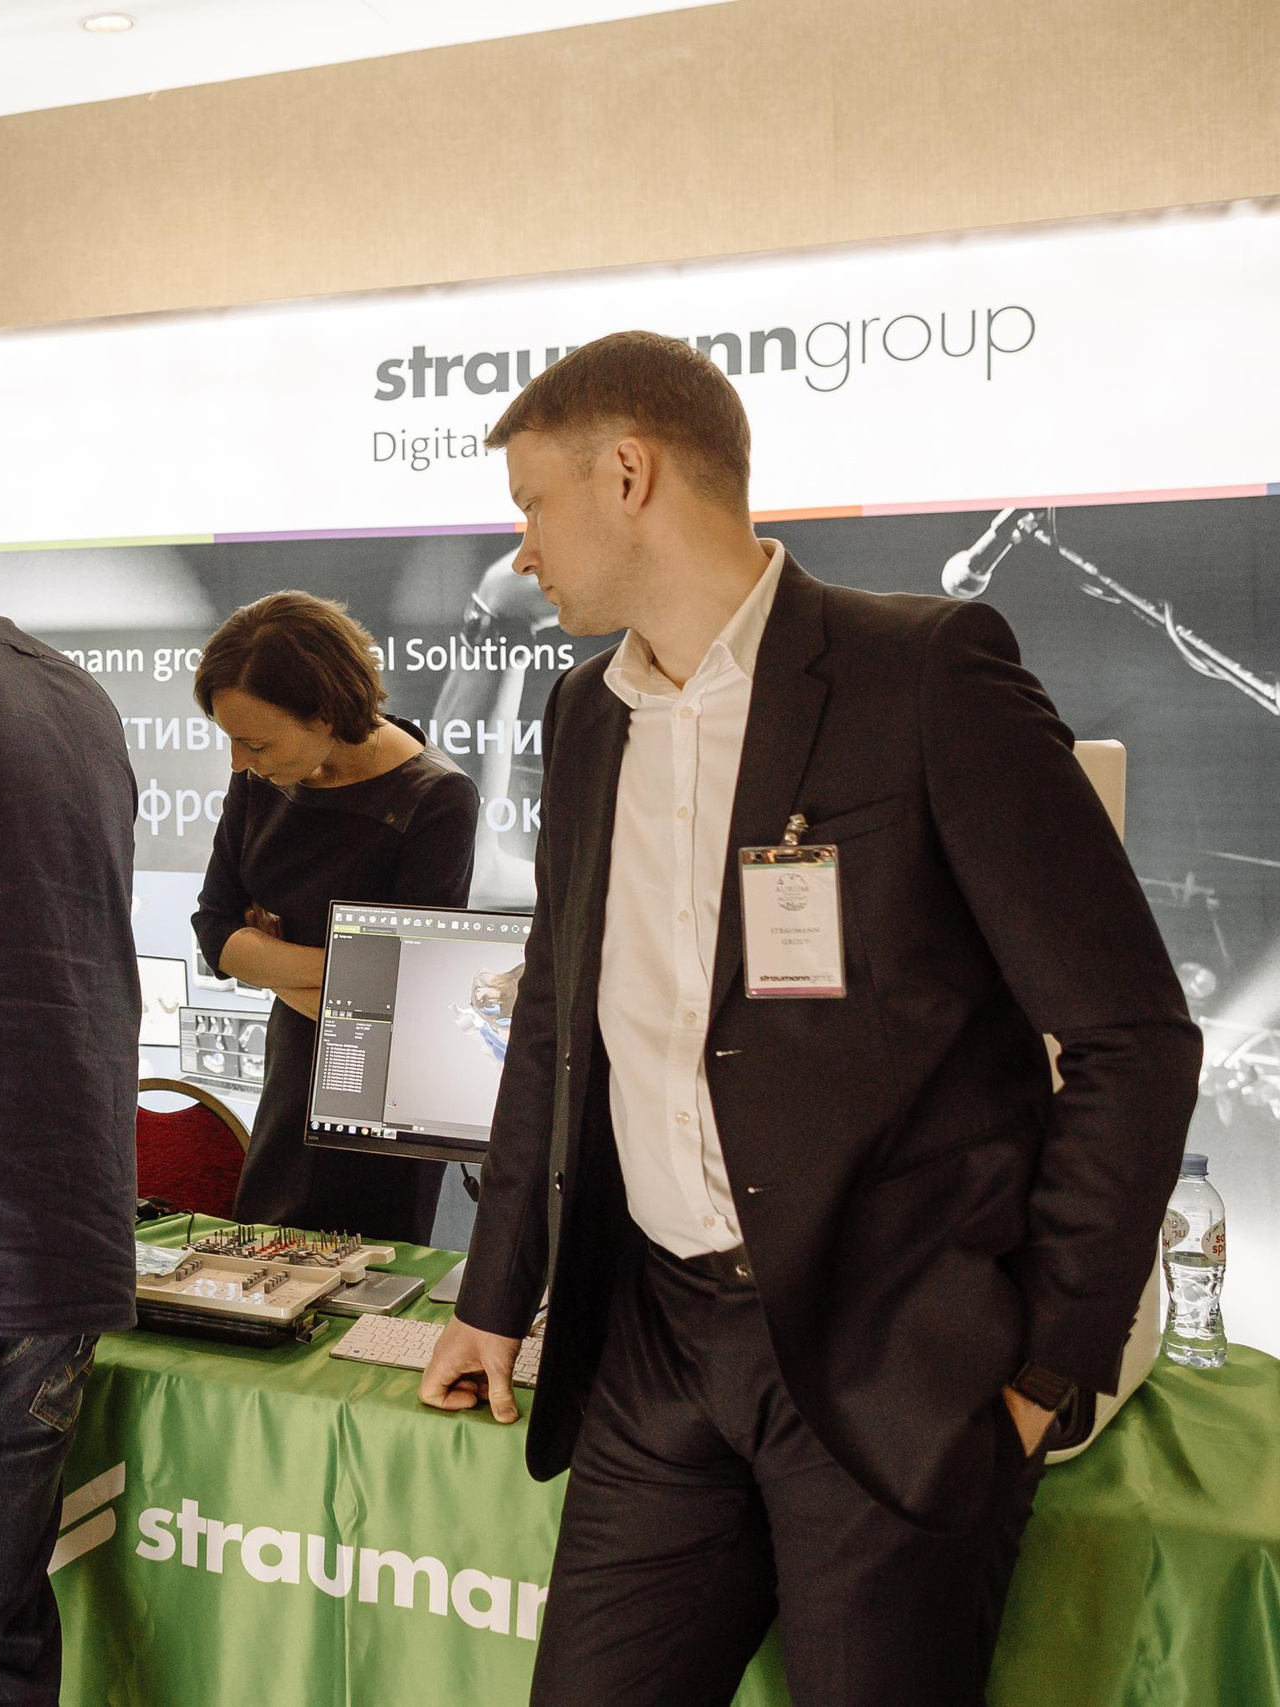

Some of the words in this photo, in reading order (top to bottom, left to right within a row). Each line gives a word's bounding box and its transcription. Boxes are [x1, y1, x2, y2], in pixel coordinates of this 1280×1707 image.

[374, 305, 1036, 402] straunngroup
[373, 423, 488, 471] Digital
[405, 636, 575, 672] Solutions
